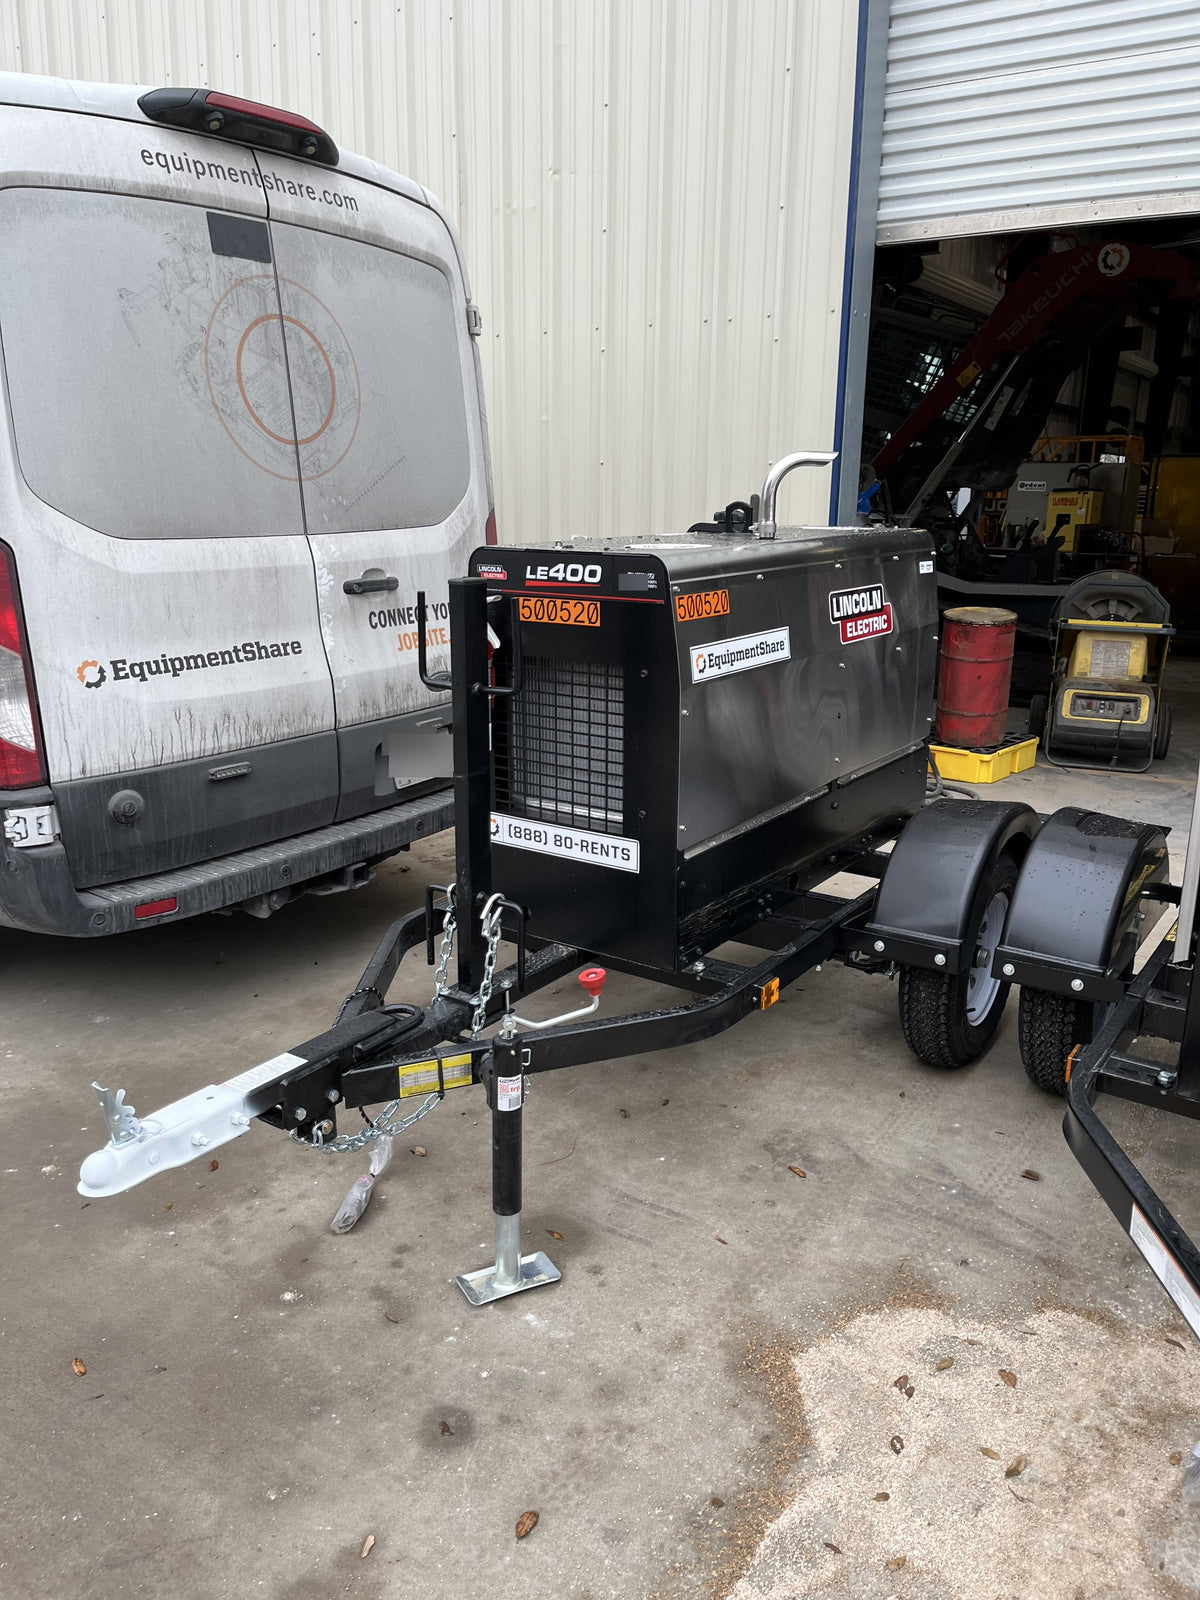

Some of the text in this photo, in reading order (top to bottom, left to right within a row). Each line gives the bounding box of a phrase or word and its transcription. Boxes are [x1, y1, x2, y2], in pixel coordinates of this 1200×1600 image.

[140, 148, 359, 212] equipmentshare.com
[478, 565, 502, 573] LINCOLN
[525, 563, 603, 583] LE400
[431, 601, 451, 621] YO
[521, 599, 599, 625] 500520
[677, 590, 729, 620] 500520
[831, 589, 882, 618] LINCOLN
[846, 614, 888, 638] ELECTRIC
[109, 640, 303, 683] EquipmentShare
[707, 639, 786, 670] EquipmentShare
[508, 823, 631, 862] (888) 80-RENTS
